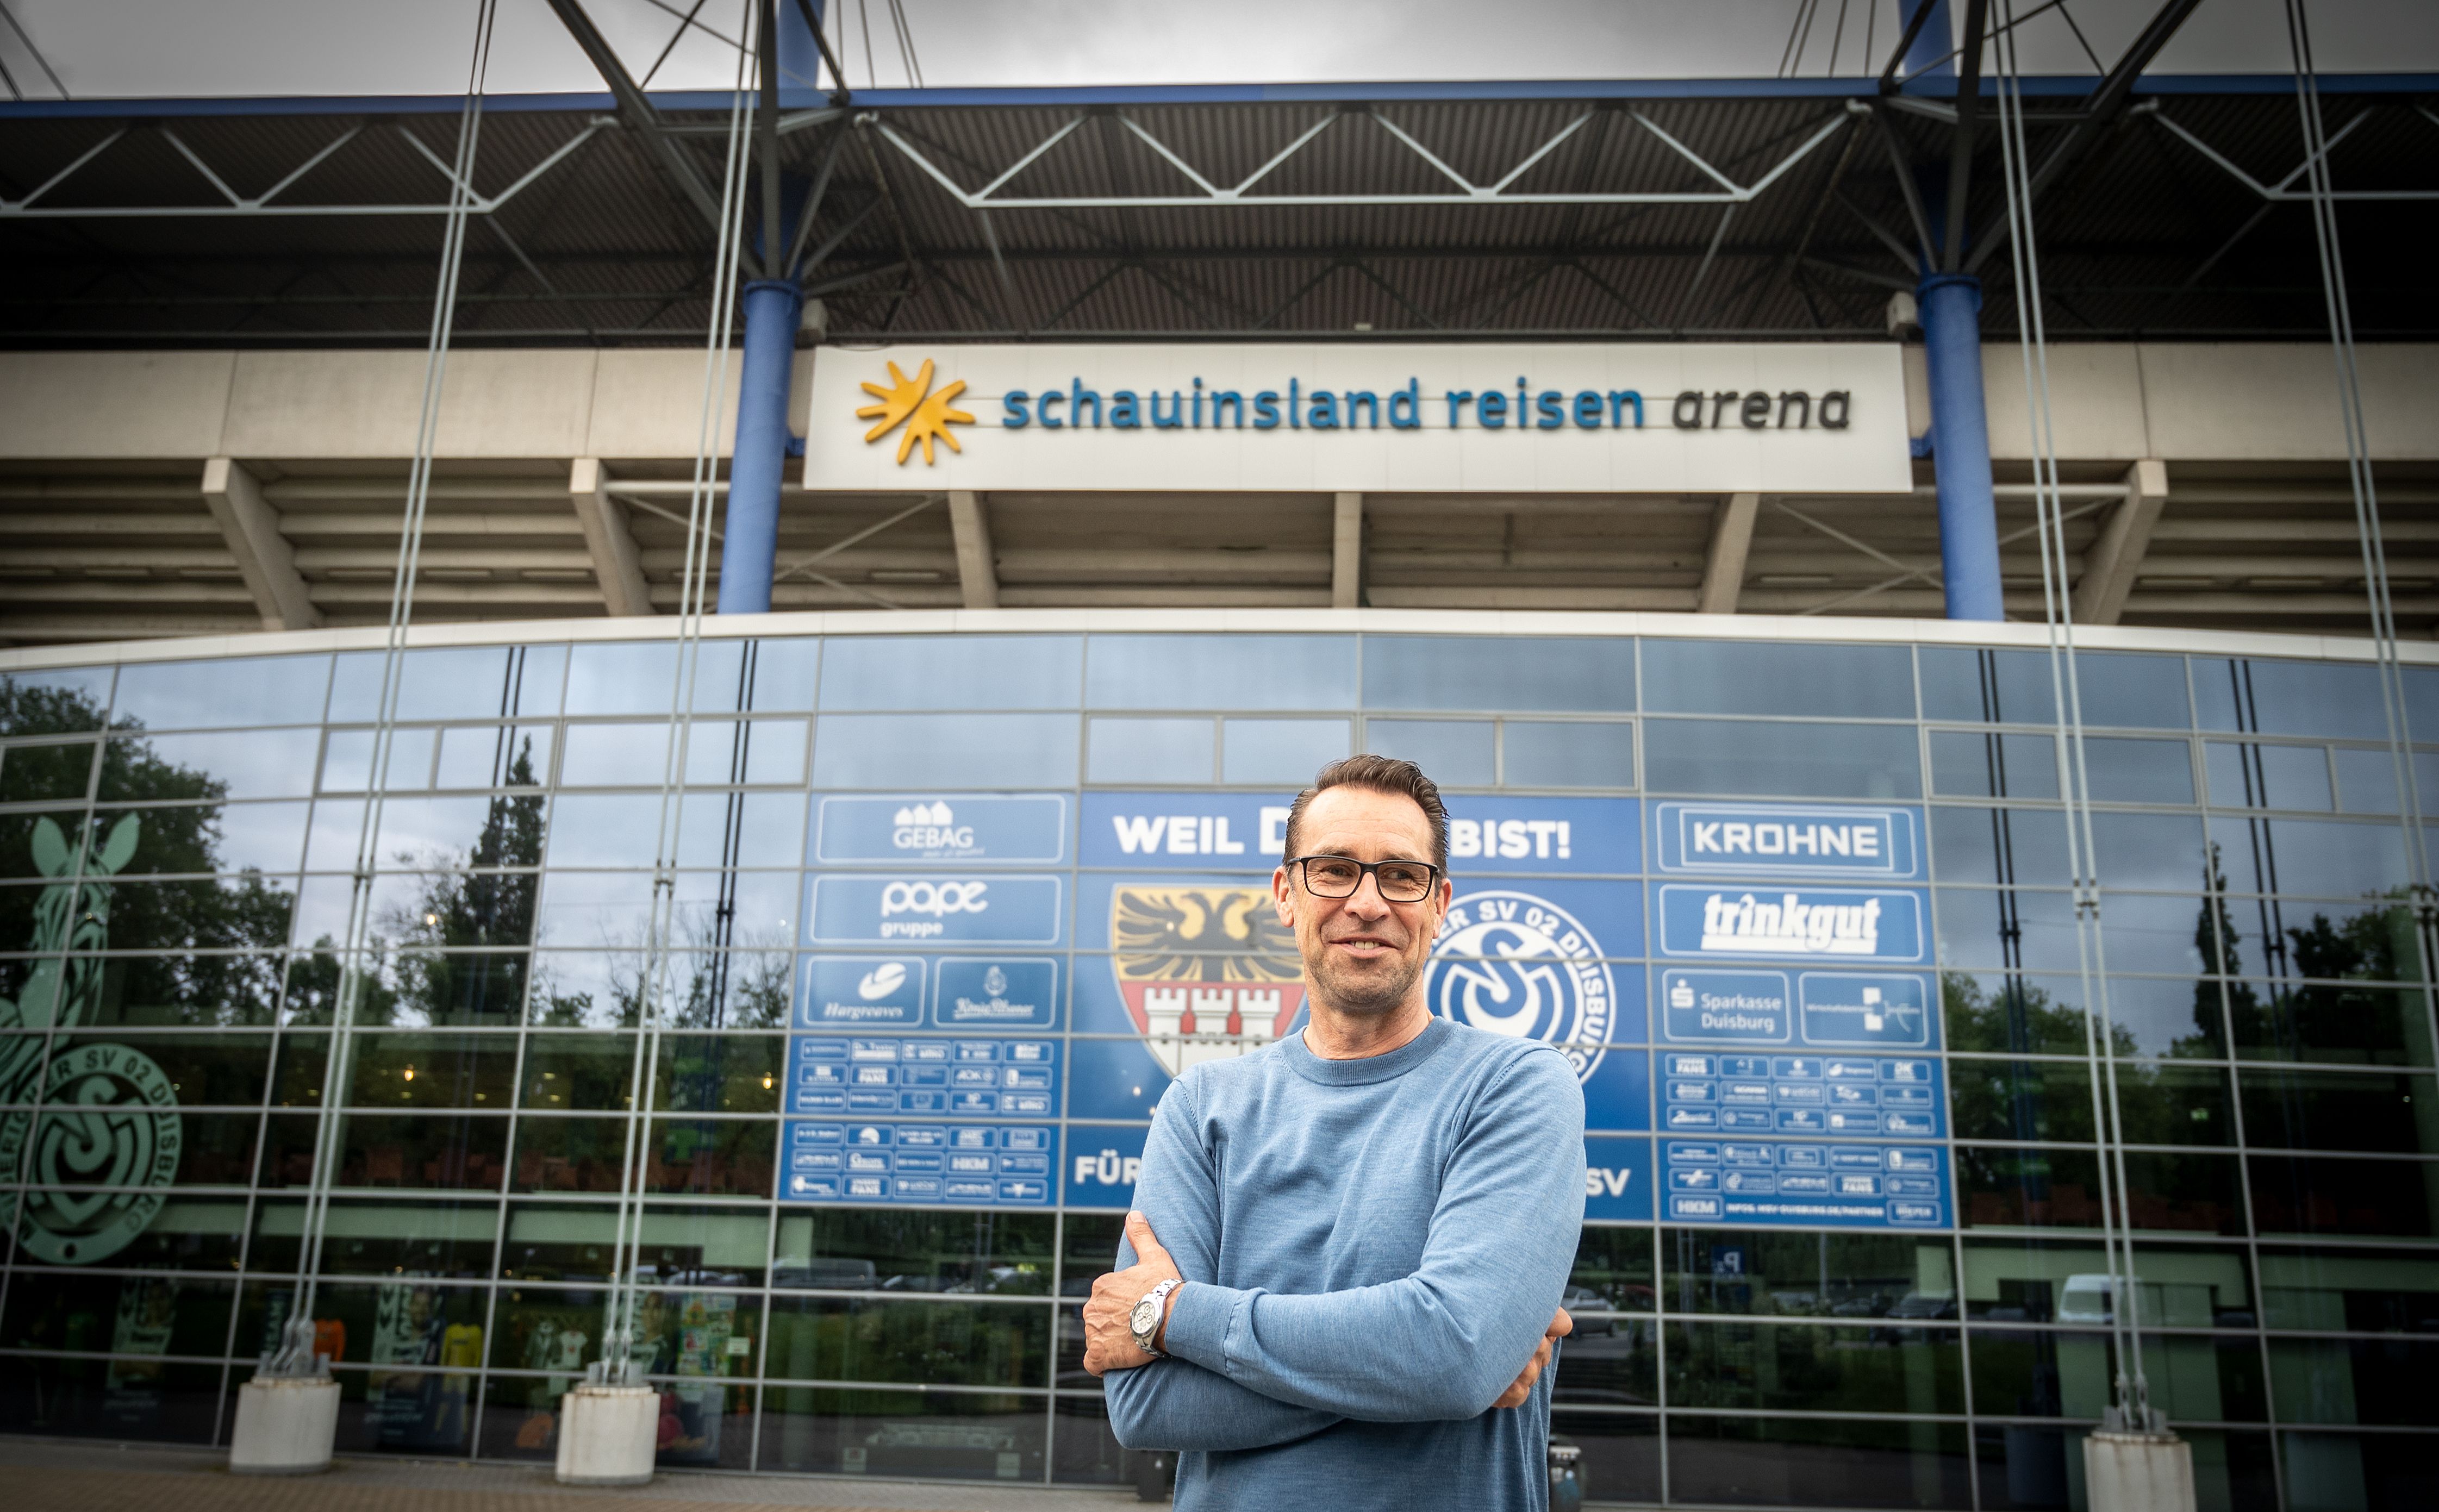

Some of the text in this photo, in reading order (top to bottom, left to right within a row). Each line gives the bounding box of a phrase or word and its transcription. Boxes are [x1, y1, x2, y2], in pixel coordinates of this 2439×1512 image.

[1002, 376, 1851, 430] schauinsland reisen arena
[893, 826, 974, 849] GEBAG
[1112, 807, 1570, 859] WEIL D BIST!
[1694, 821, 1879, 858] KROHNE
[881, 881, 988, 918] pape
[881, 921, 944, 938] gruppe
[1479, 900, 1518, 921] SV
[1525, 907, 1560, 936] 02
[1703, 893, 1881, 950] trinkgut
[824, 1002, 903, 1020] Hargreaves
[1700, 994, 1782, 1014] Sparkasse
[1701, 1013, 1775, 1034] Duisburg
[85, 1048, 117, 1071] SV
[123, 1053, 152, 1085] 02
[952, 1157, 989, 1171] HKM
[1075, 1148, 1140, 1186] FÜR
[1677, 1199, 1716, 1214] HKM
